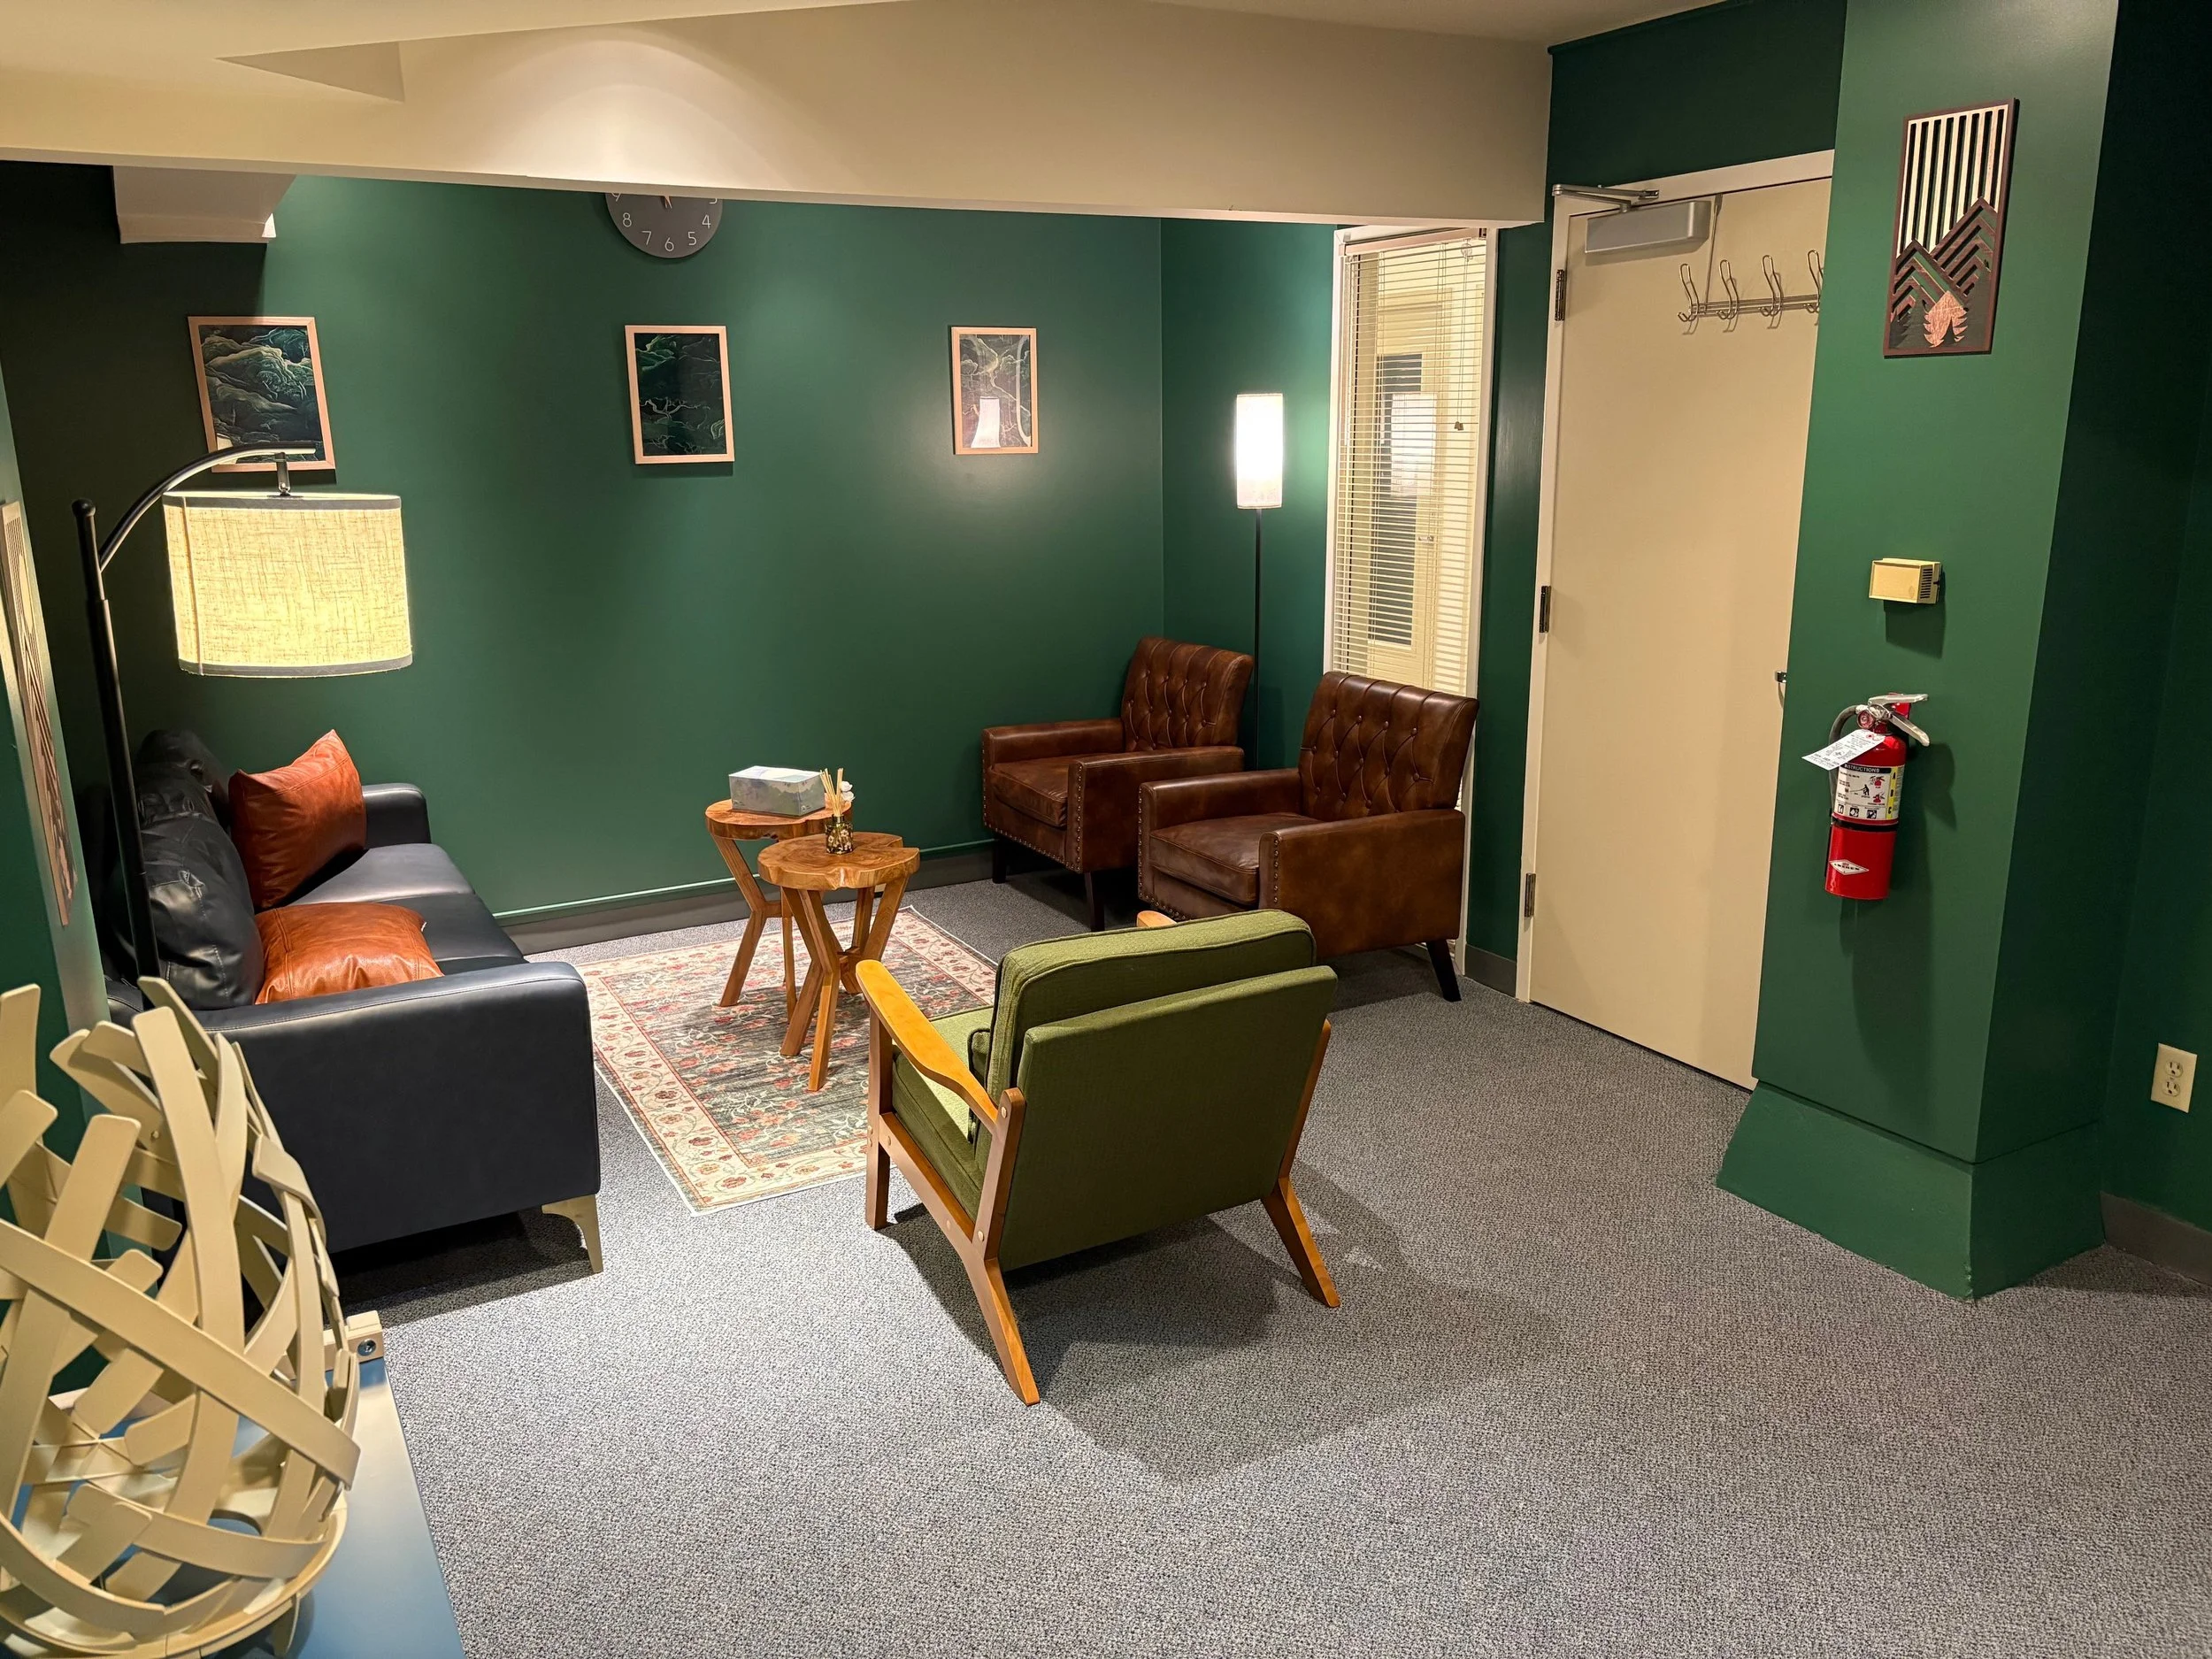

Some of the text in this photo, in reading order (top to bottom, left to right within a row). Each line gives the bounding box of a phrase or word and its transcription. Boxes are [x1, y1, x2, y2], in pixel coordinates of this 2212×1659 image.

[622, 212, 632, 227] 8
[702, 214, 711, 228] 4
[641, 230, 652, 245] 7
[664, 237, 674, 252] 6
[687, 231, 697, 246] 5
